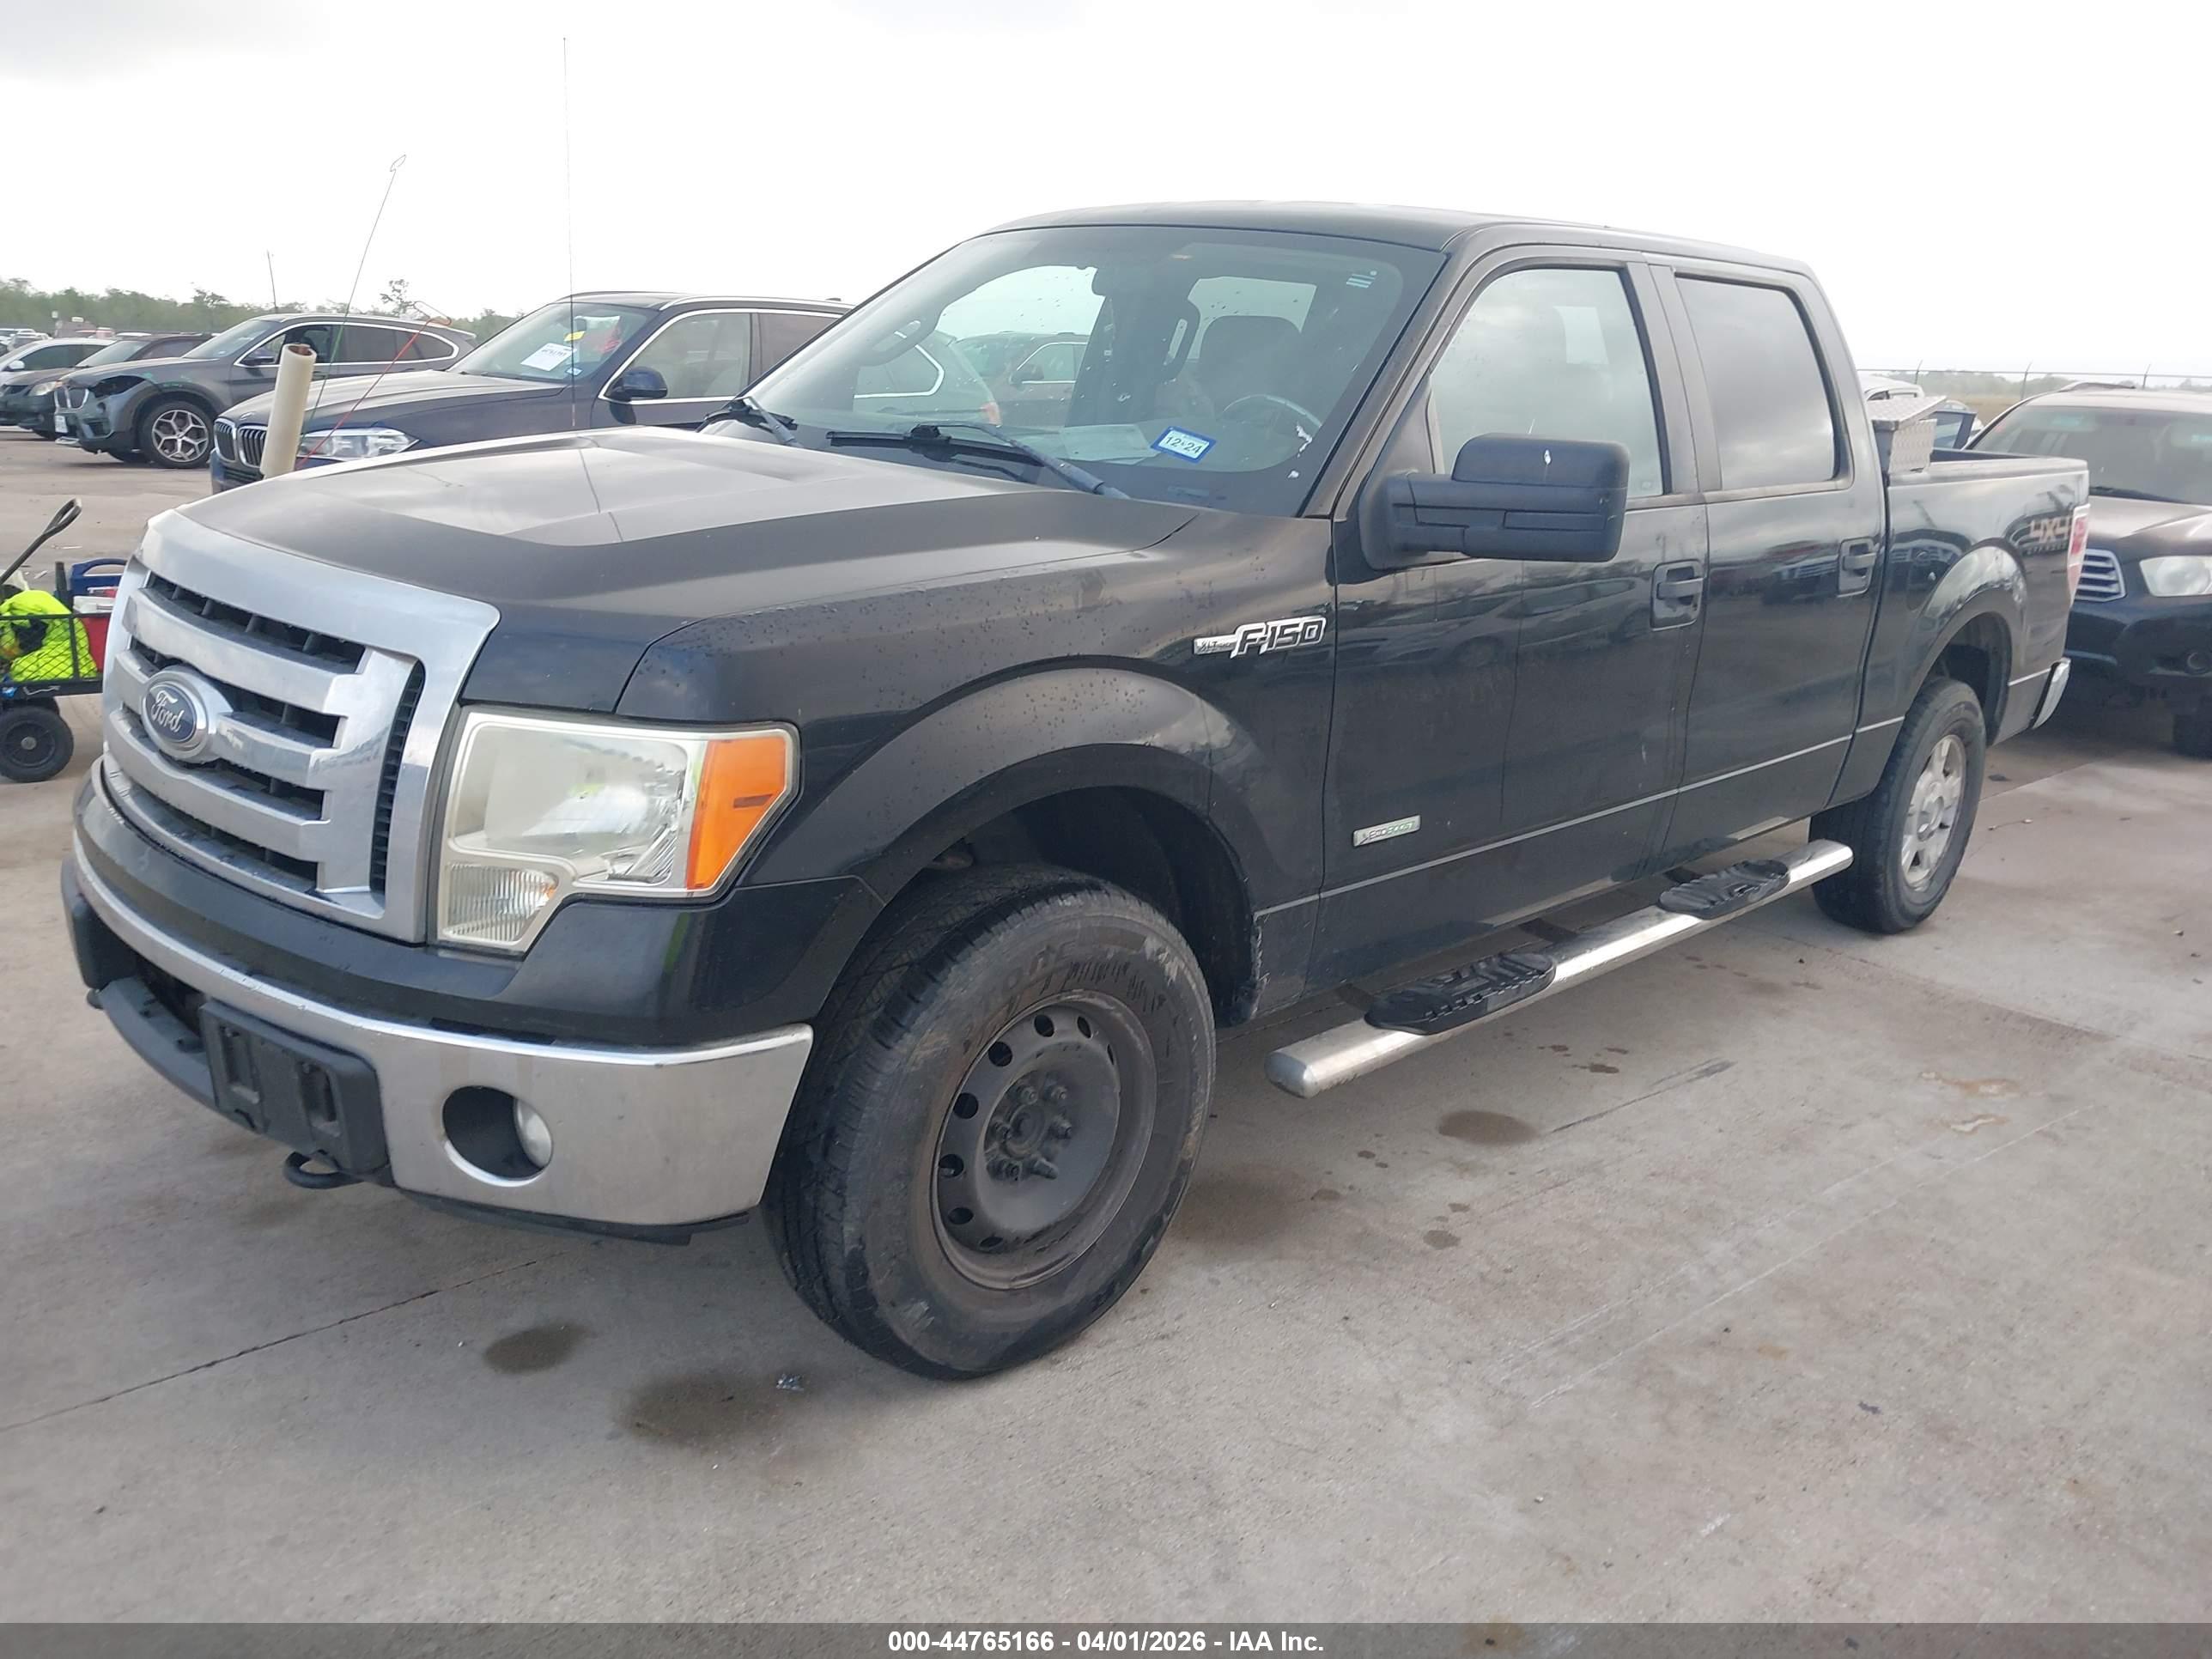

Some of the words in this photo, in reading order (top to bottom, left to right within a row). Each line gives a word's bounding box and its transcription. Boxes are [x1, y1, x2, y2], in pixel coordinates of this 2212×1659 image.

[1165, 435, 1182, 447] 12
[1183, 442, 1202, 454] 24
[1229, 615, 1327, 659] F-150
[150, 690, 185, 732] Ford
